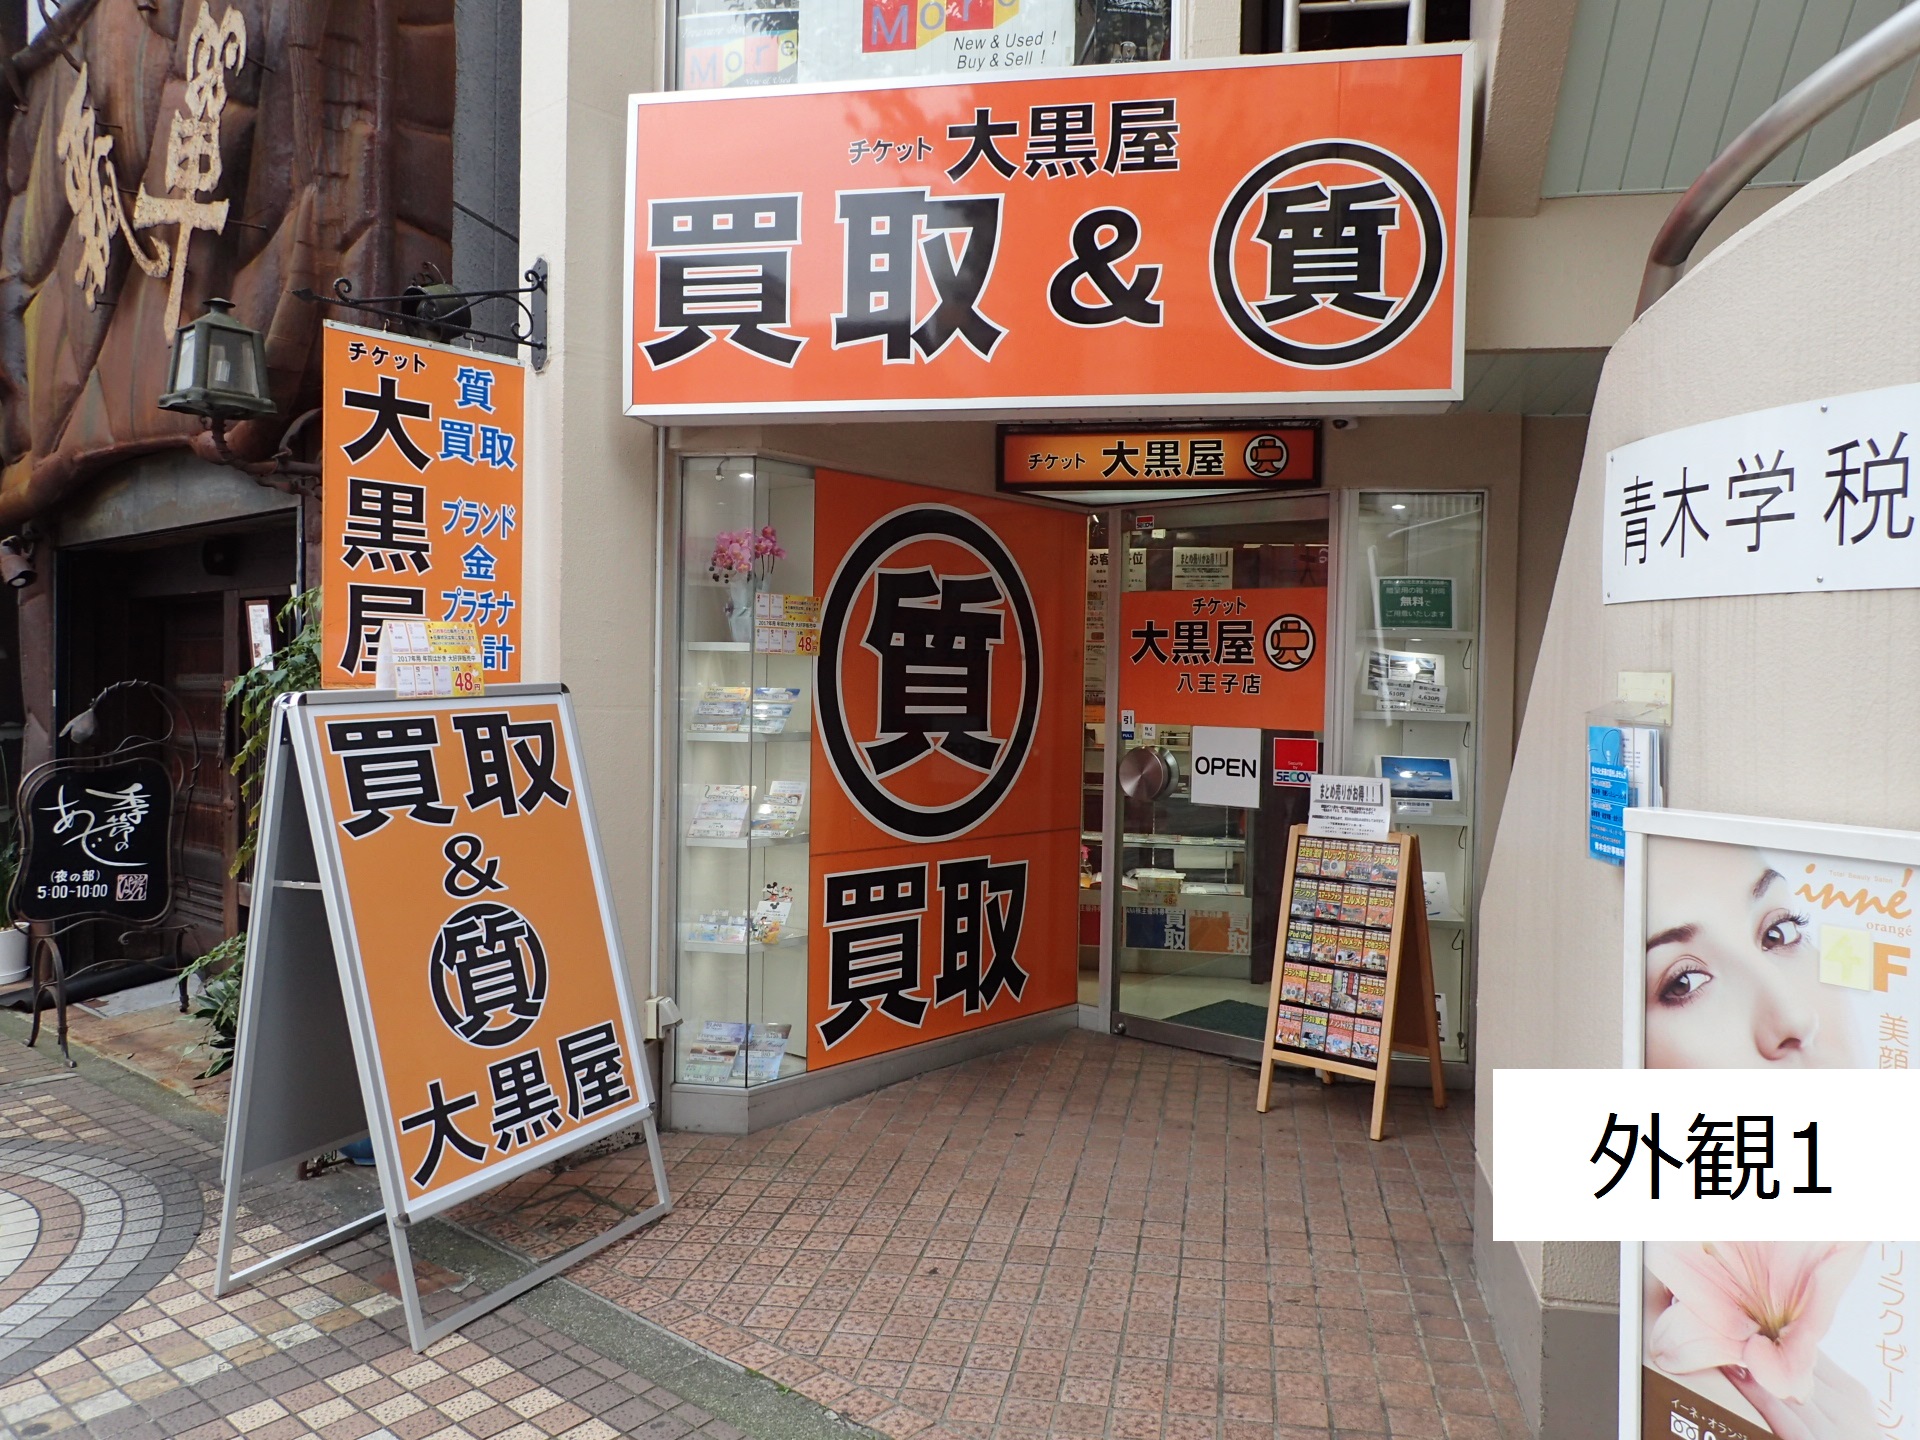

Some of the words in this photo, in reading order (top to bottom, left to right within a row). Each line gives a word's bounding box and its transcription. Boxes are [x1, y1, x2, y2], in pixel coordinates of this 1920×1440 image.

[690, 39, 796, 84] More
[953, 37, 988, 51] New
[991, 36, 1000, 49] &
[1005, 32, 1043, 48] Used
[957, 54, 984, 71] Buy
[989, 54, 999, 67] &
[1004, 51, 1033, 66] Sell
[848, 133, 934, 165] チケット
[945, 97, 1181, 180] 大黒屋
[638, 186, 1009, 371] 買取
[1048, 207, 1164, 329] &
[1252, 179, 1404, 326] 質
[348, 341, 427, 374] チケット
[454, 365, 496, 414] 質
[436, 418, 518, 472] 買取
[1028, 451, 1087, 471] チケット
[1101, 438, 1226, 479] 大黒屋
[441, 496, 516, 540] ブランド
[1620, 431, 1915, 566] 青木学税
[338, 374, 434, 677] 大黒屋
[460, 542, 498, 582] 金
[441, 586, 515, 628] プラチナ
[1192, 596, 1247, 617] チケット
[1130, 619, 1256, 667] 大黒屋
[858, 563, 1006, 783] 質
[1175, 672, 1262, 695] 八王子店
[324, 711, 572, 841] 買取
[1195, 756, 1257, 779] OPEN
[441, 832, 509, 898] &
[1829, 869, 1845, 877] Total
[1848, 872, 1871, 882] Beauty
[1874, 875, 1893, 884] Salon
[1164, 908, 1185, 950] 買取
[1866, 920, 1912, 938] orangé
[439, 907, 544, 1043] 質
[815, 855, 1030, 1052] 買取
[399, 1019, 632, 1188] 大黒屋
[1875, 1242, 1908, 1440] リラクゼーシ
